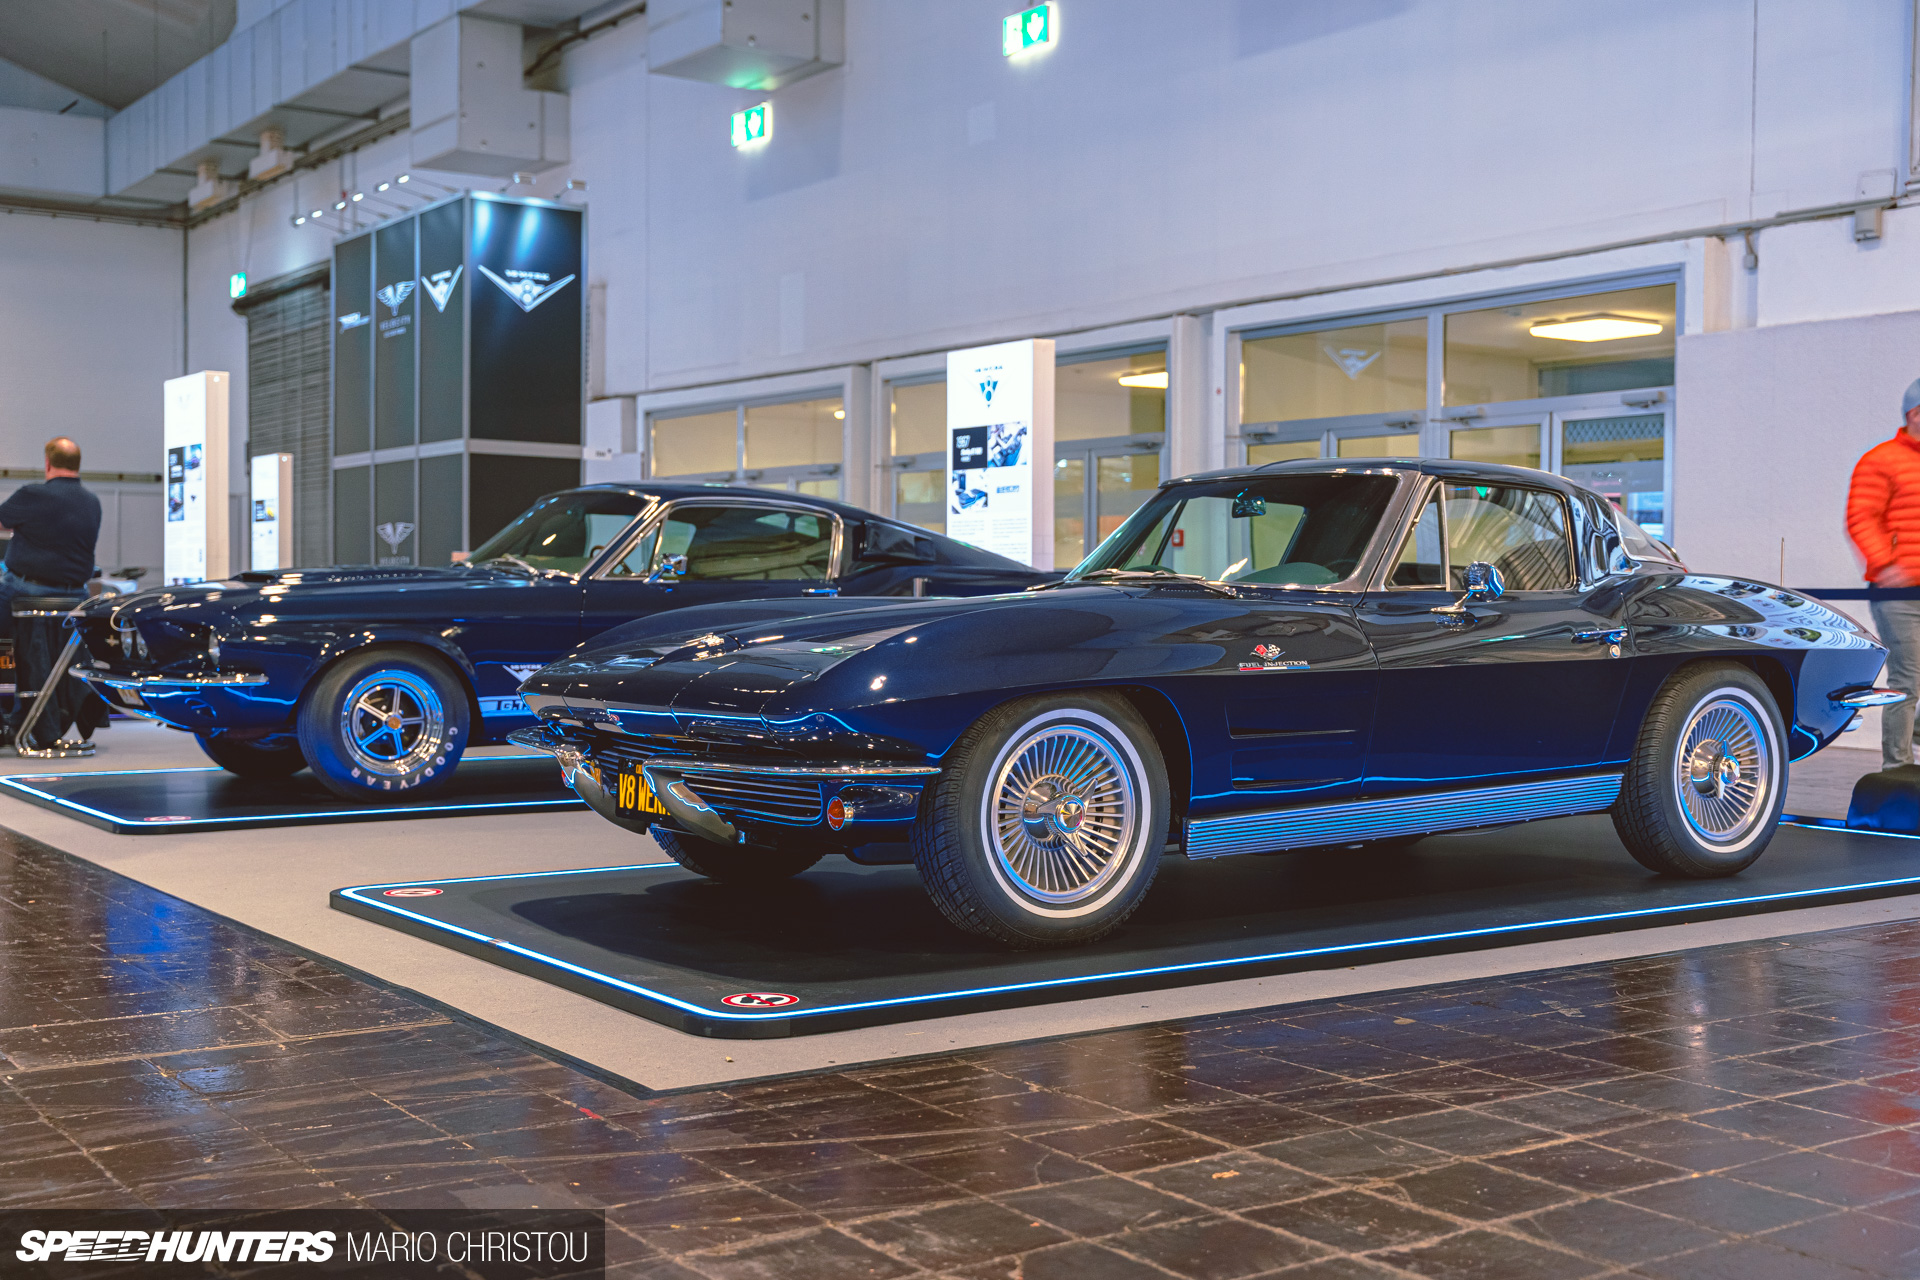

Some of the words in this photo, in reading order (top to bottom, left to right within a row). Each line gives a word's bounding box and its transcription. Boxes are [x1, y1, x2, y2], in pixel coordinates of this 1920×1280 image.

[351, 726, 458, 790] GOODYEAR
[619, 773, 636, 810] V8
[637, 776, 671, 816] WE
